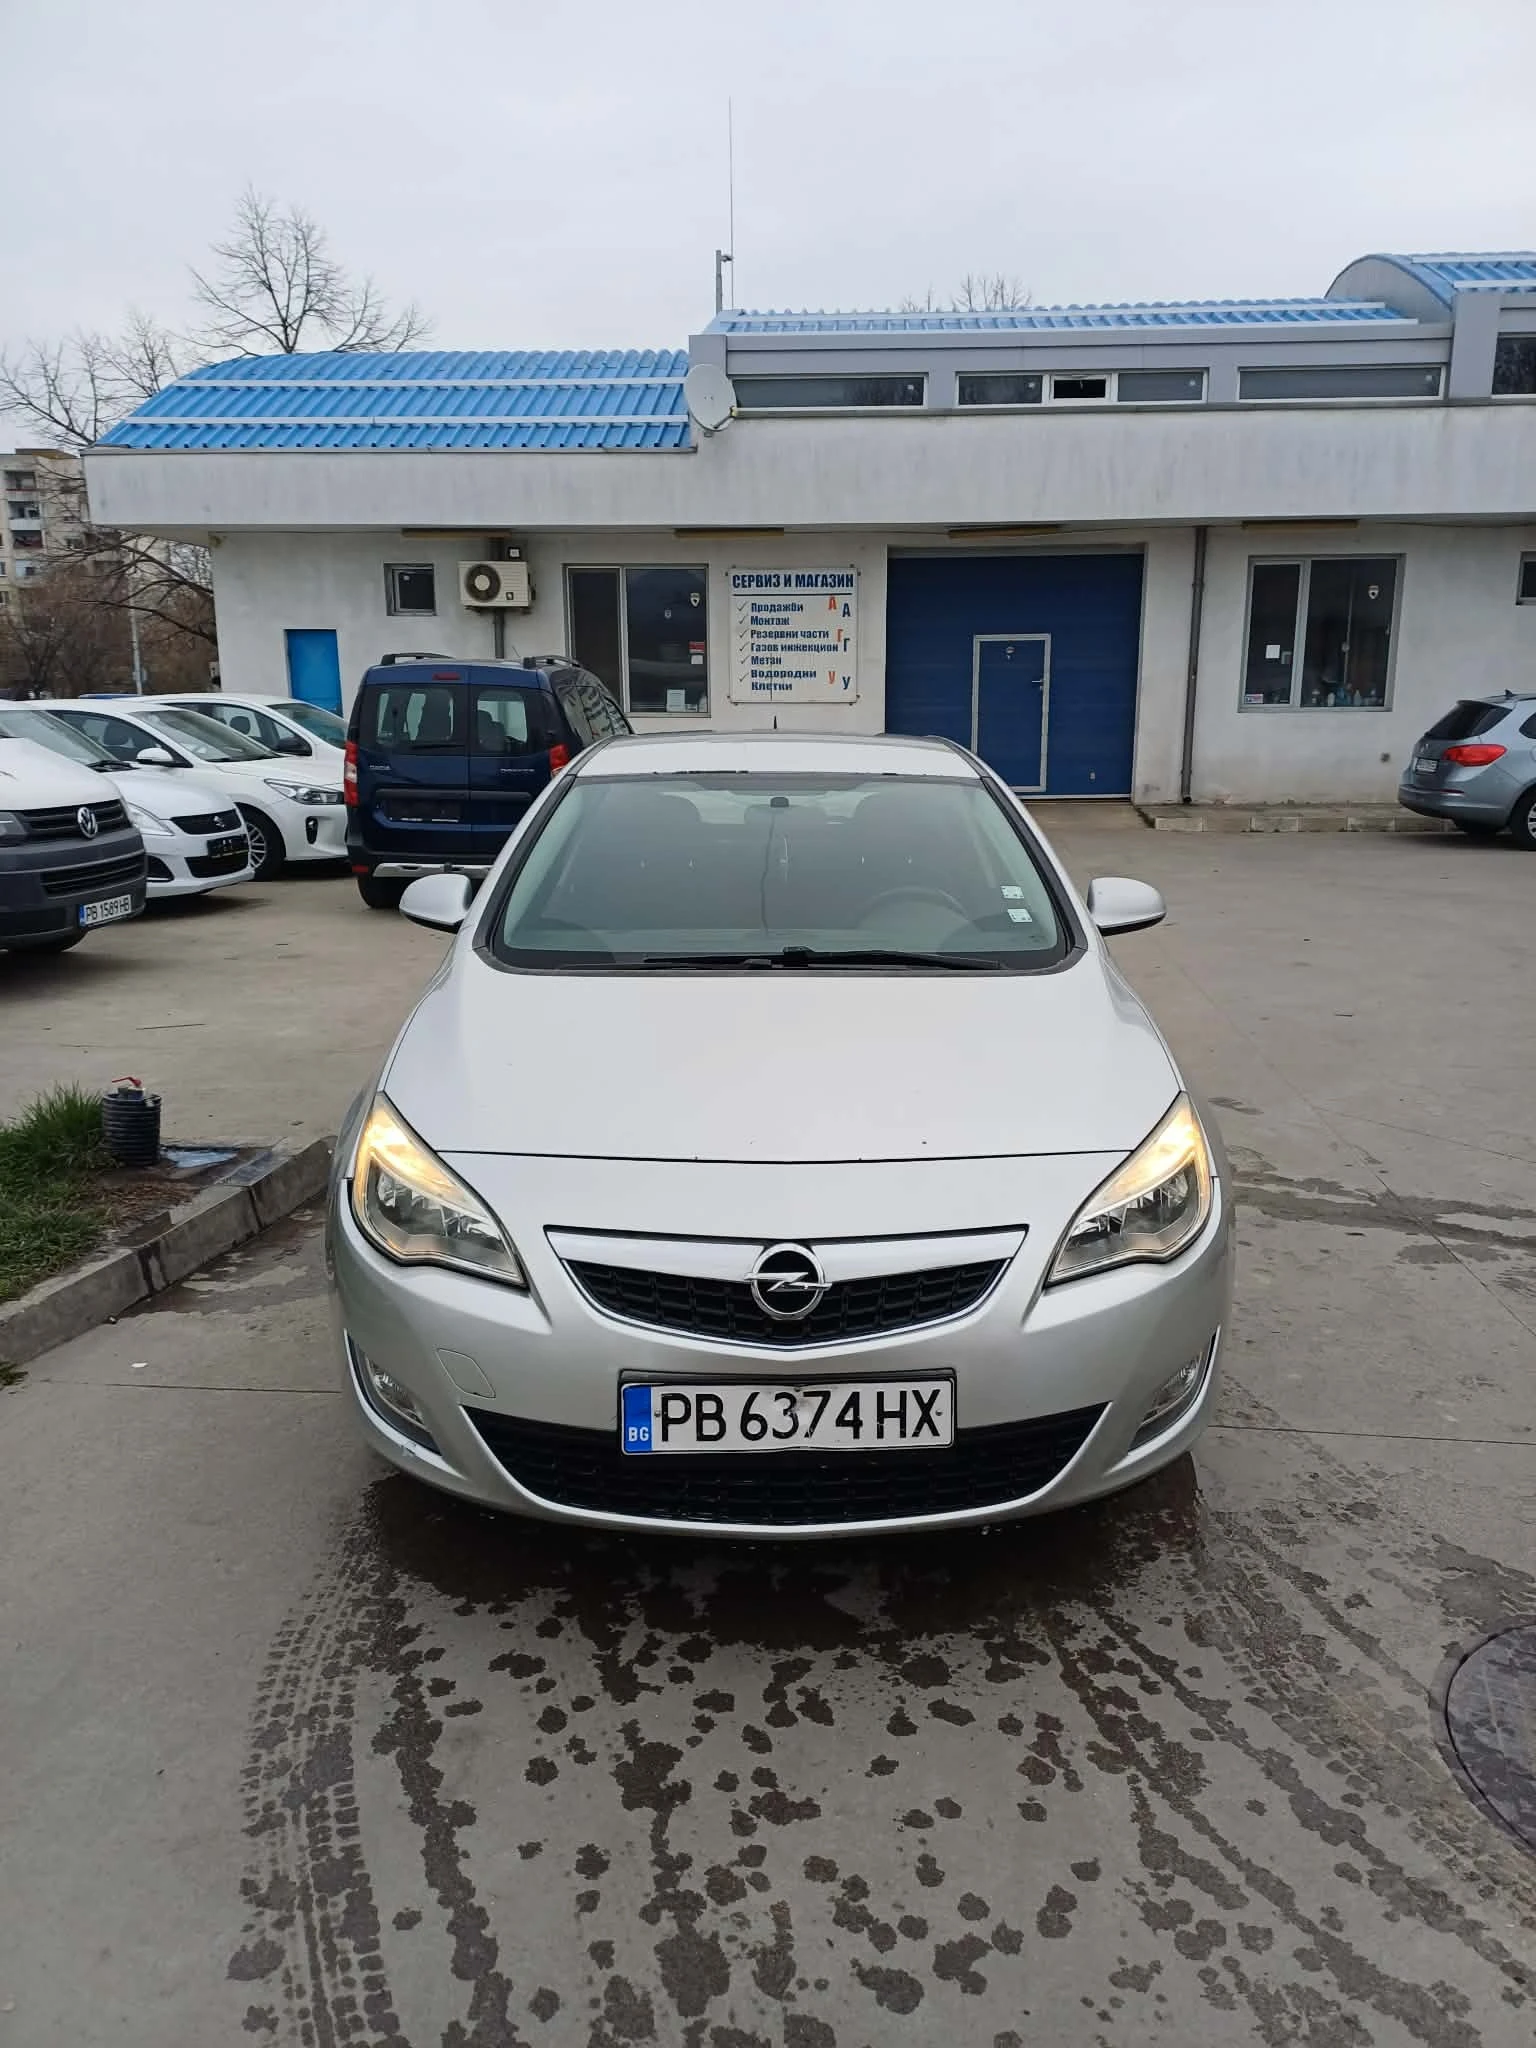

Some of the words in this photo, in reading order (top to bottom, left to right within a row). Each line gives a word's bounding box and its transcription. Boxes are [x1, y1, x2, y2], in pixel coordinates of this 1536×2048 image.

[732, 574, 781, 589] СЕРВИЗ
[784, 574, 792, 587] И
[795, 573, 854, 588] МАГАЗИН
[751, 602, 803, 613] Продажби
[750, 615, 790, 626] Монтаж
[750, 629, 798, 639] Резервни
[800, 630, 829, 639] части
[751, 642, 778, 652] Газов
[780, 643, 839, 654] инжекцион
[751, 656, 782, 665] Метан
[751, 669, 816, 679] Водородни
[660, 1392, 727, 1442] PB
[739, 1390, 864, 1441] 6374
[875, 1388, 941, 1440] HX
[627, 1426, 650, 1442] BG
